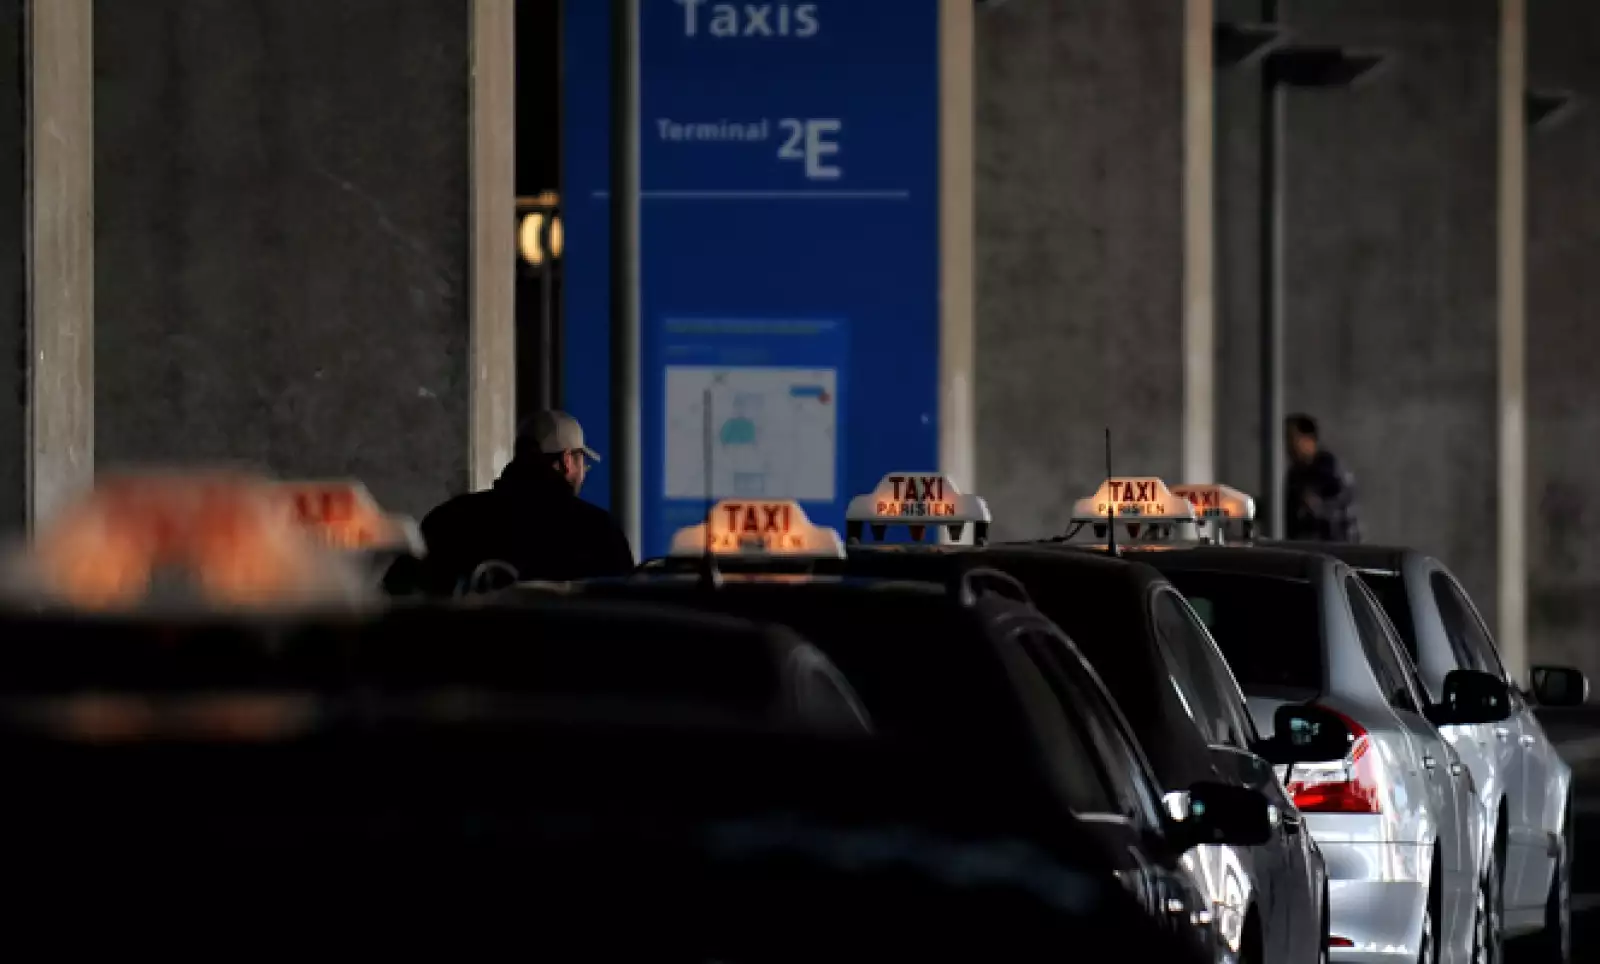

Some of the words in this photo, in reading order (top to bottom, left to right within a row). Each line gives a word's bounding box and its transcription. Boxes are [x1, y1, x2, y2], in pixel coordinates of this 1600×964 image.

[676, 0, 819, 37] Taxis
[656, 118, 769, 141] Terminal
[777, 118, 842, 180] 2E
[889, 476, 944, 501] TAXI
[1109, 481, 1157, 502] TAXI
[723, 504, 792, 533] TAXI
[876, 502, 955, 517] PARISIEN
[1098, 503, 1165, 516] PRISIEN
